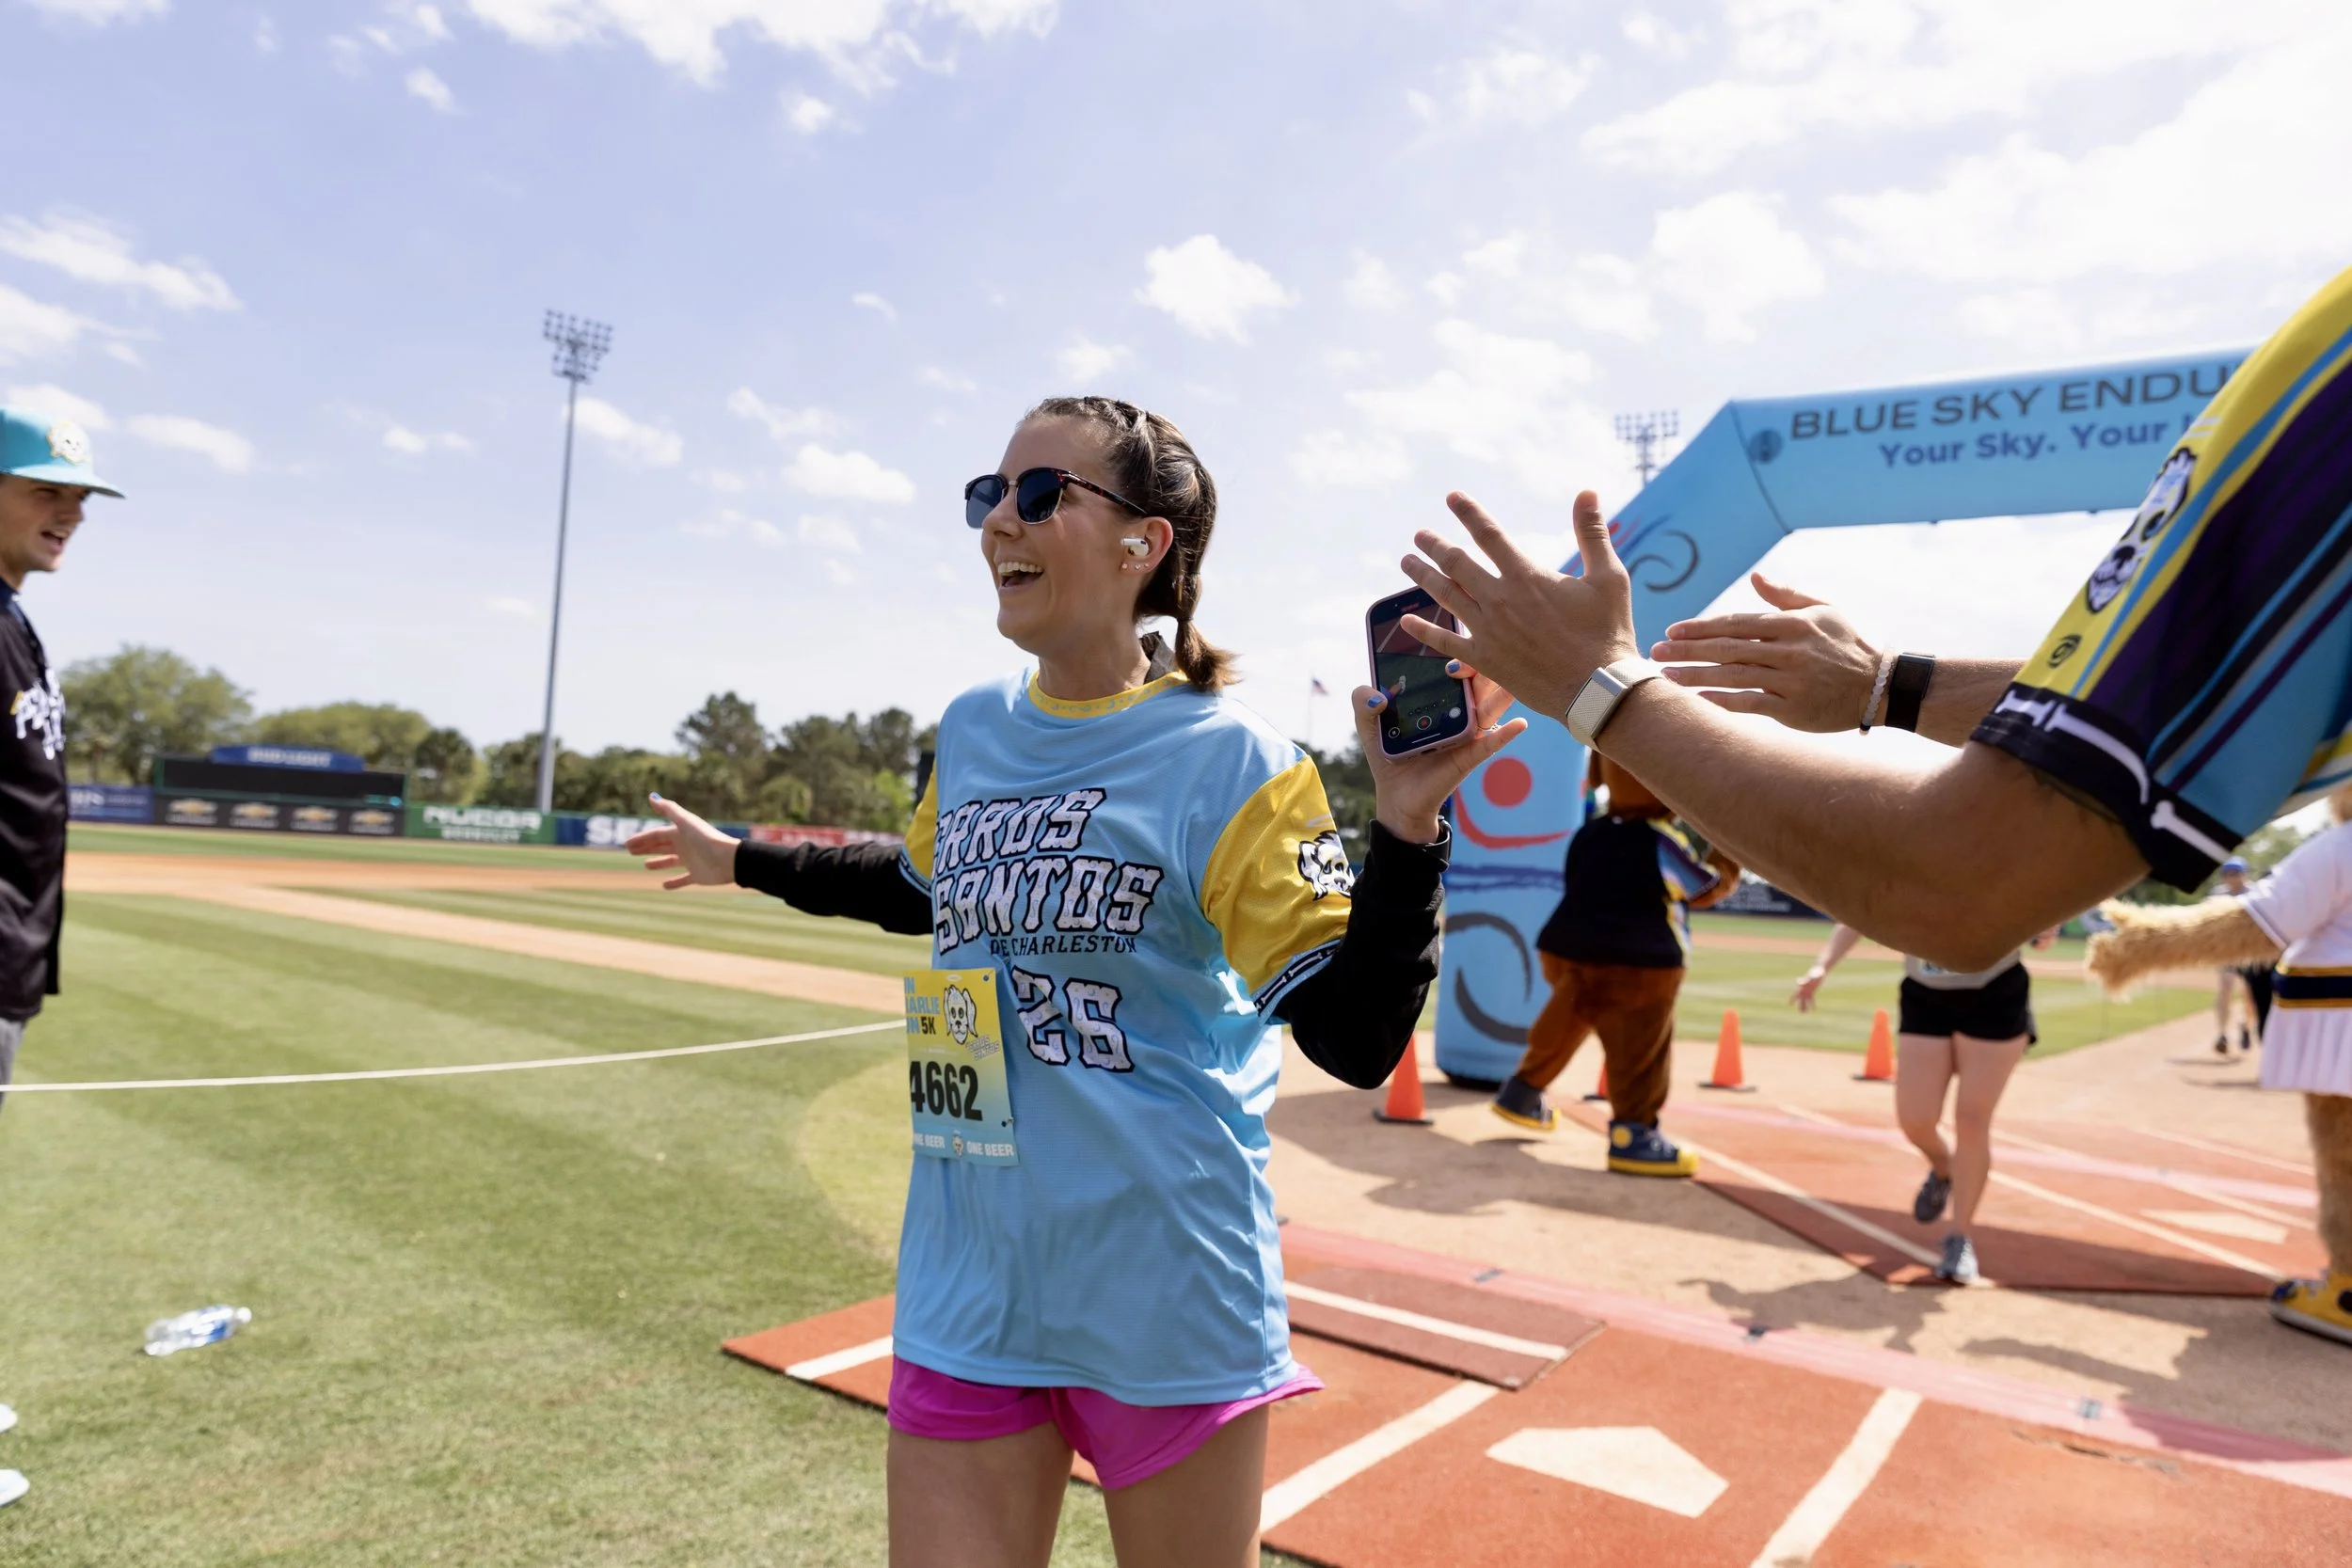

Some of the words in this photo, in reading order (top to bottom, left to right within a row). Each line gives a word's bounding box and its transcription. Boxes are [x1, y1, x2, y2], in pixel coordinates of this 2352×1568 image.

[1791, 400, 1918, 440] BLUE
[1931, 387, 2043, 426] SKY
[2058, 365, 2230, 412] ENDU
[1879, 437, 1963, 468] Your
[1976, 428, 2057, 463] Sky.
[2069, 419, 2168, 451] Your
[934, 855, 1165, 957] SANTOS
[990, 938, 1010, 957] DE
[1011, 934, 1136, 957] CHARLESTON
[921, 1016, 936, 1035] 5K
[1011, 964, 1136, 1072] 26
[909, 1060, 983, 1121] 4662
[925, 1133, 946, 1148] BEER
[966, 1140, 983, 1155] ONE
[984, 1142, 1014, 1157] BEER
